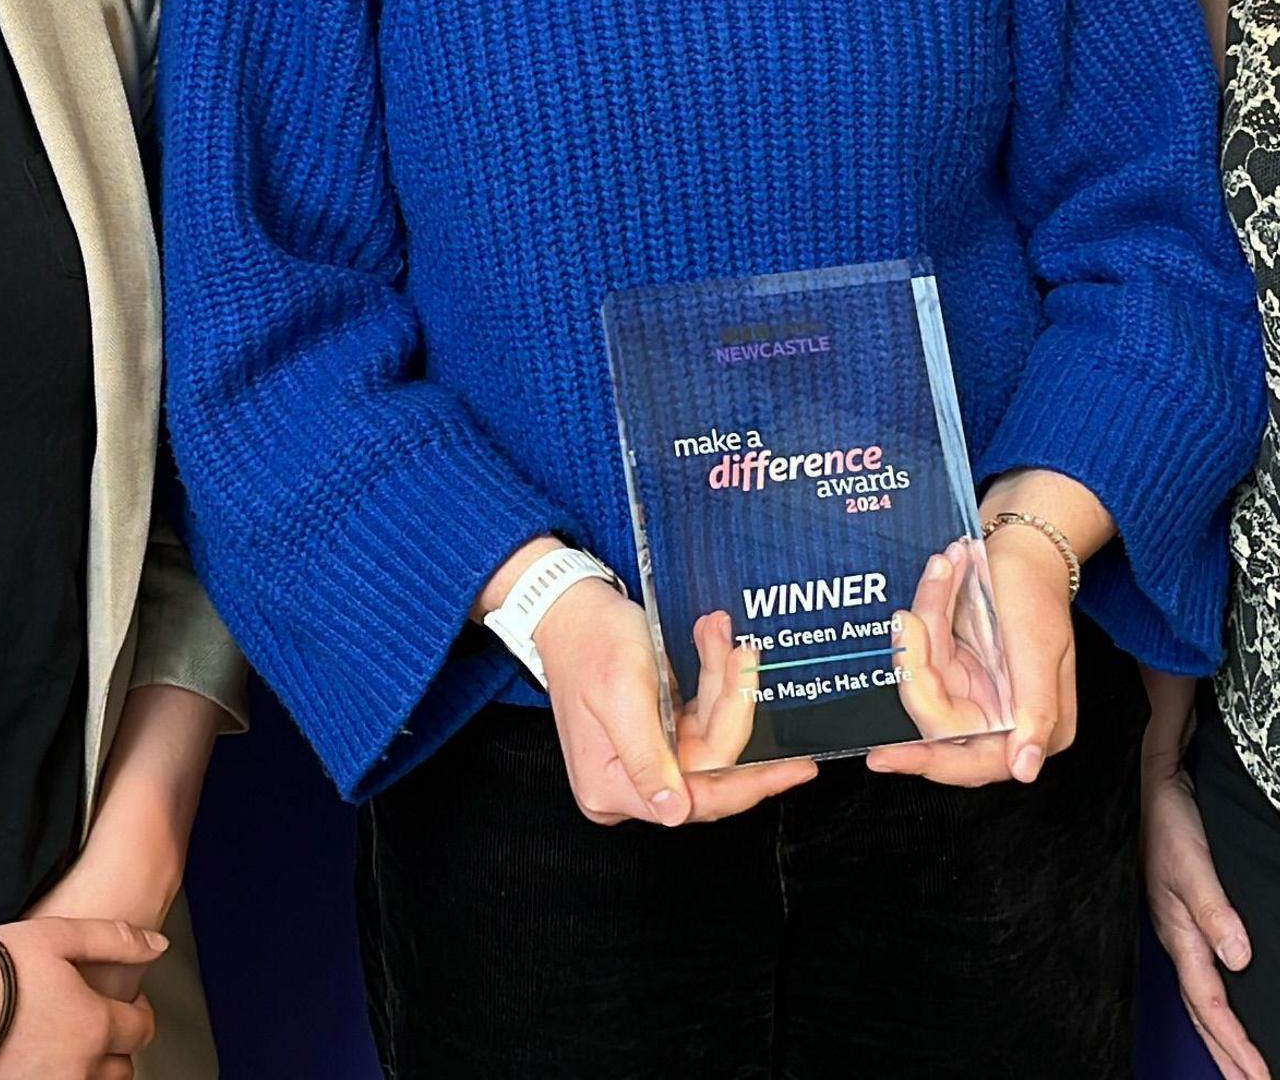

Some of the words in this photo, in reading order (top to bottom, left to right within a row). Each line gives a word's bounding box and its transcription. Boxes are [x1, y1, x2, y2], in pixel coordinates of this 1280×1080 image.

[715, 336, 831, 363] NEWCASTLE
[673, 428, 741, 457] make
[746, 430, 763, 448] a
[708, 445, 883, 492] difference
[816, 465, 910, 498] awards
[845, 494, 891, 513] 2024
[742, 572, 888, 620] WINNER
[735, 633, 774, 651] The
[778, 626, 837, 648] Green
[841, 614, 903, 640] Award
[738, 685, 775, 704] The
[777, 677, 832, 701] Magic
[834, 672, 870, 692] Hat
